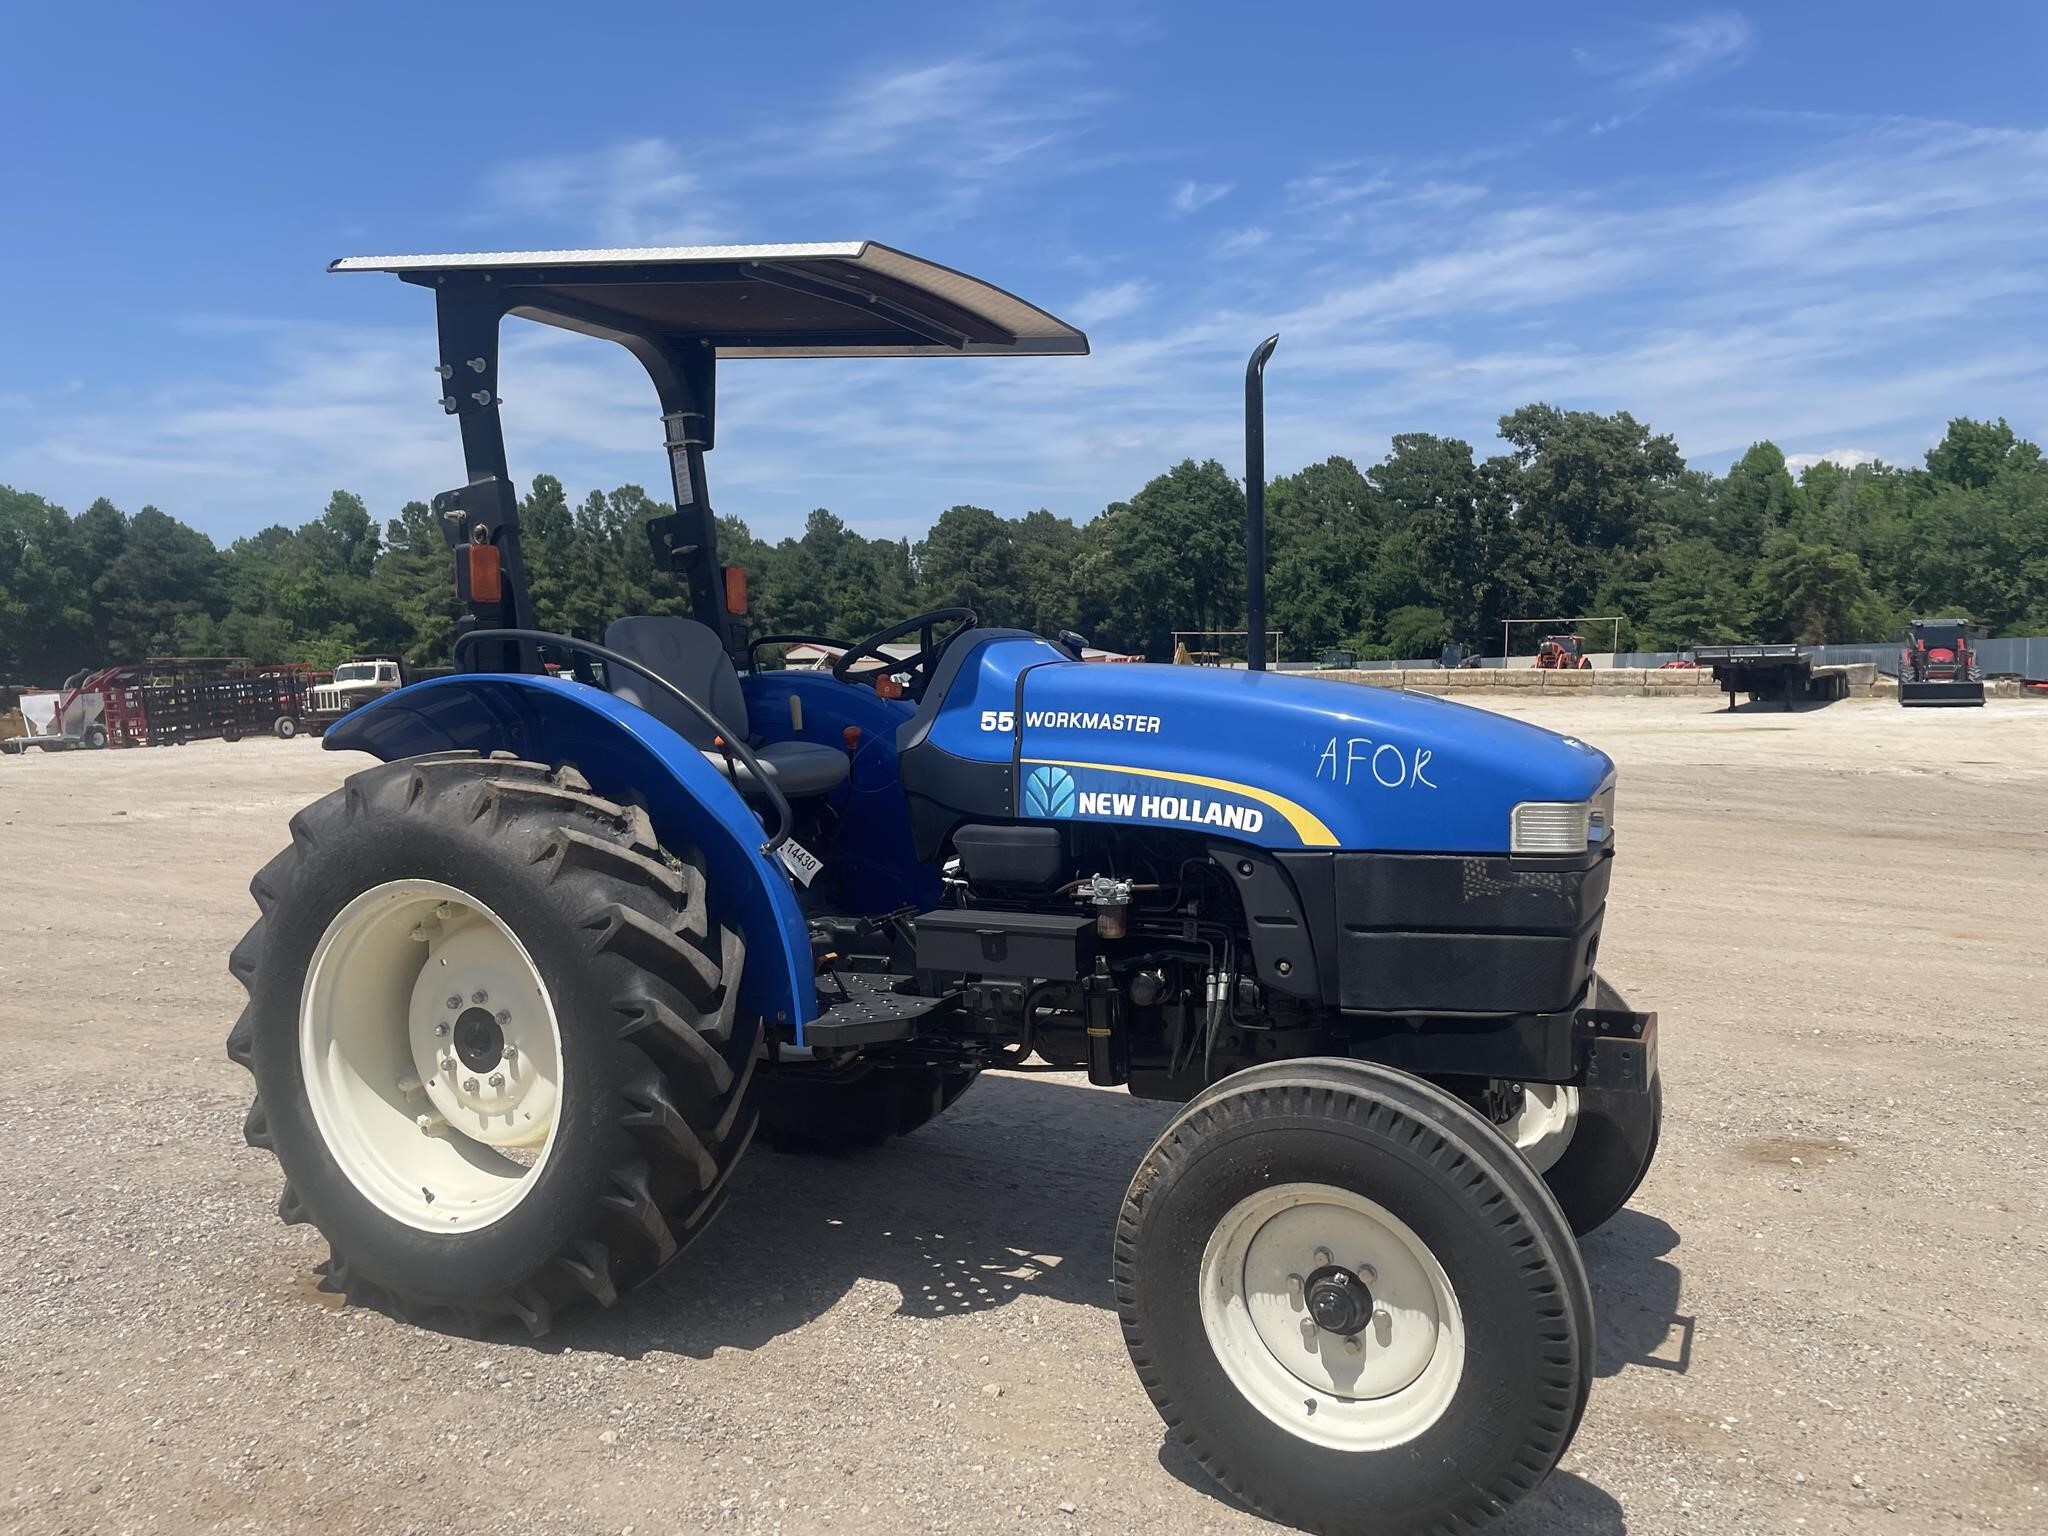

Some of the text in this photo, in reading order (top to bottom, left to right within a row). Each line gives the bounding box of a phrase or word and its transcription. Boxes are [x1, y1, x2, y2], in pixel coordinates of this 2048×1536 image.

[980, 711, 1161, 734] 55 WORKMASTER
[1079, 792, 1264, 833] NEW HOLLAND
[786, 843, 816, 871] 14430
